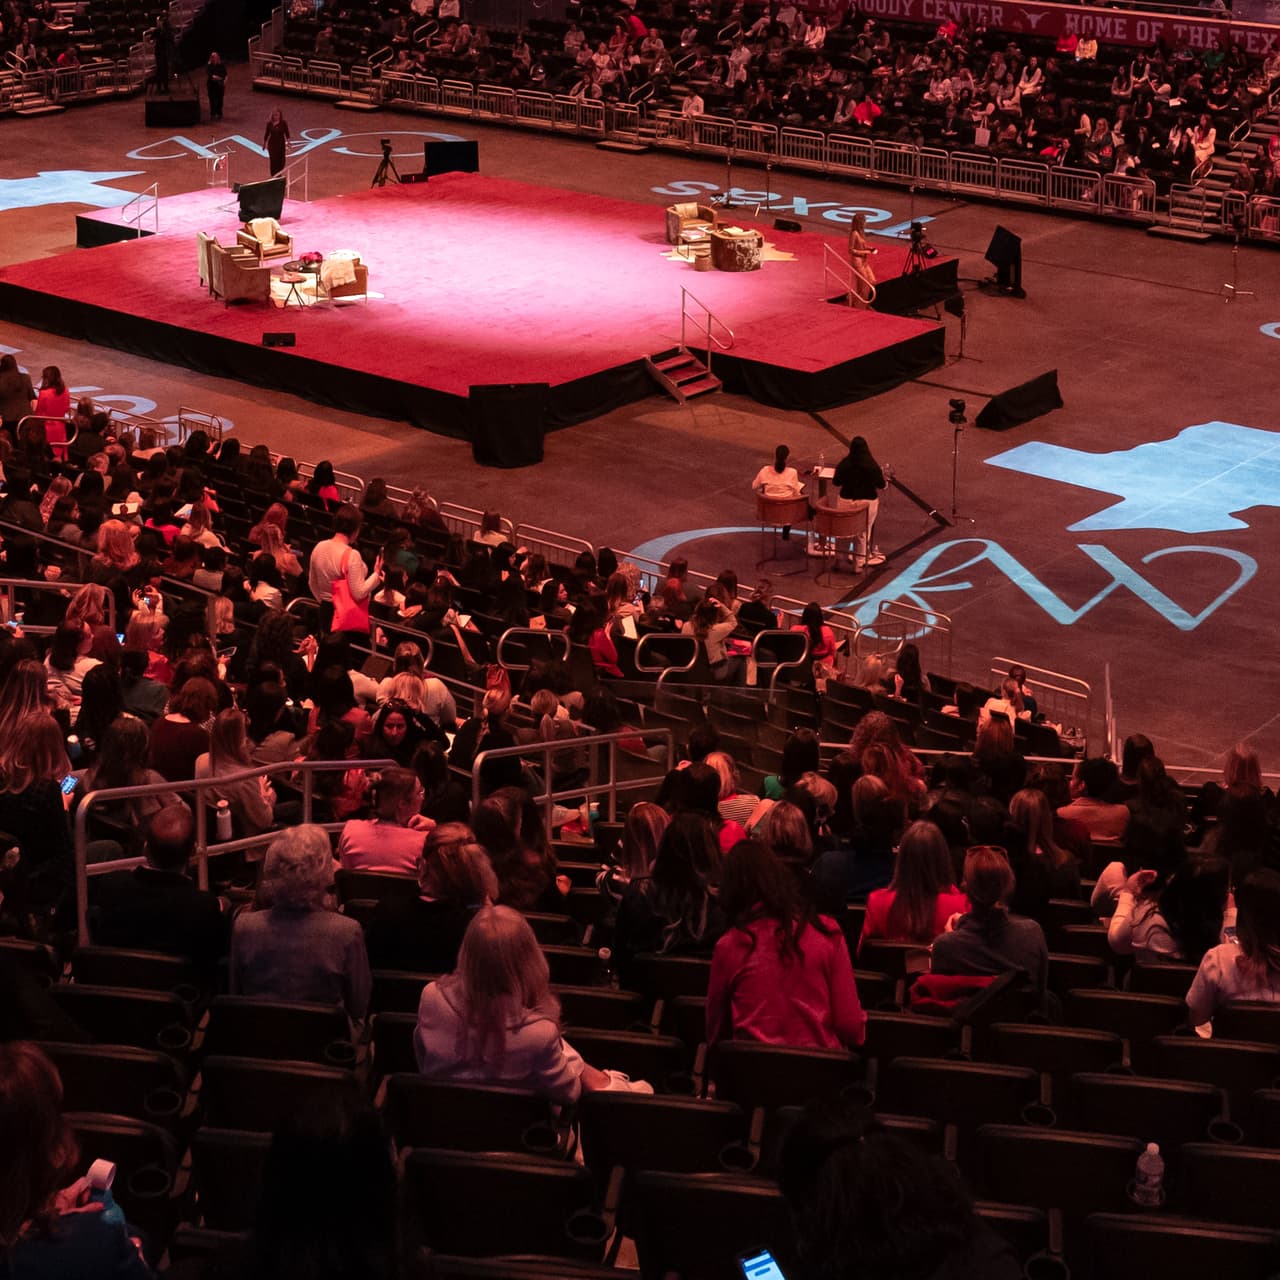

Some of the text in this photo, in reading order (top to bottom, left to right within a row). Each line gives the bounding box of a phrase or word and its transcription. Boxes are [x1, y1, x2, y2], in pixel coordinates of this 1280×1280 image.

[922, 0, 1004, 26] CENTER
[1065, 12, 1128, 39] HOME
[1136, 20, 1164, 42] OF
[1173, 23, 1220, 49] THE
